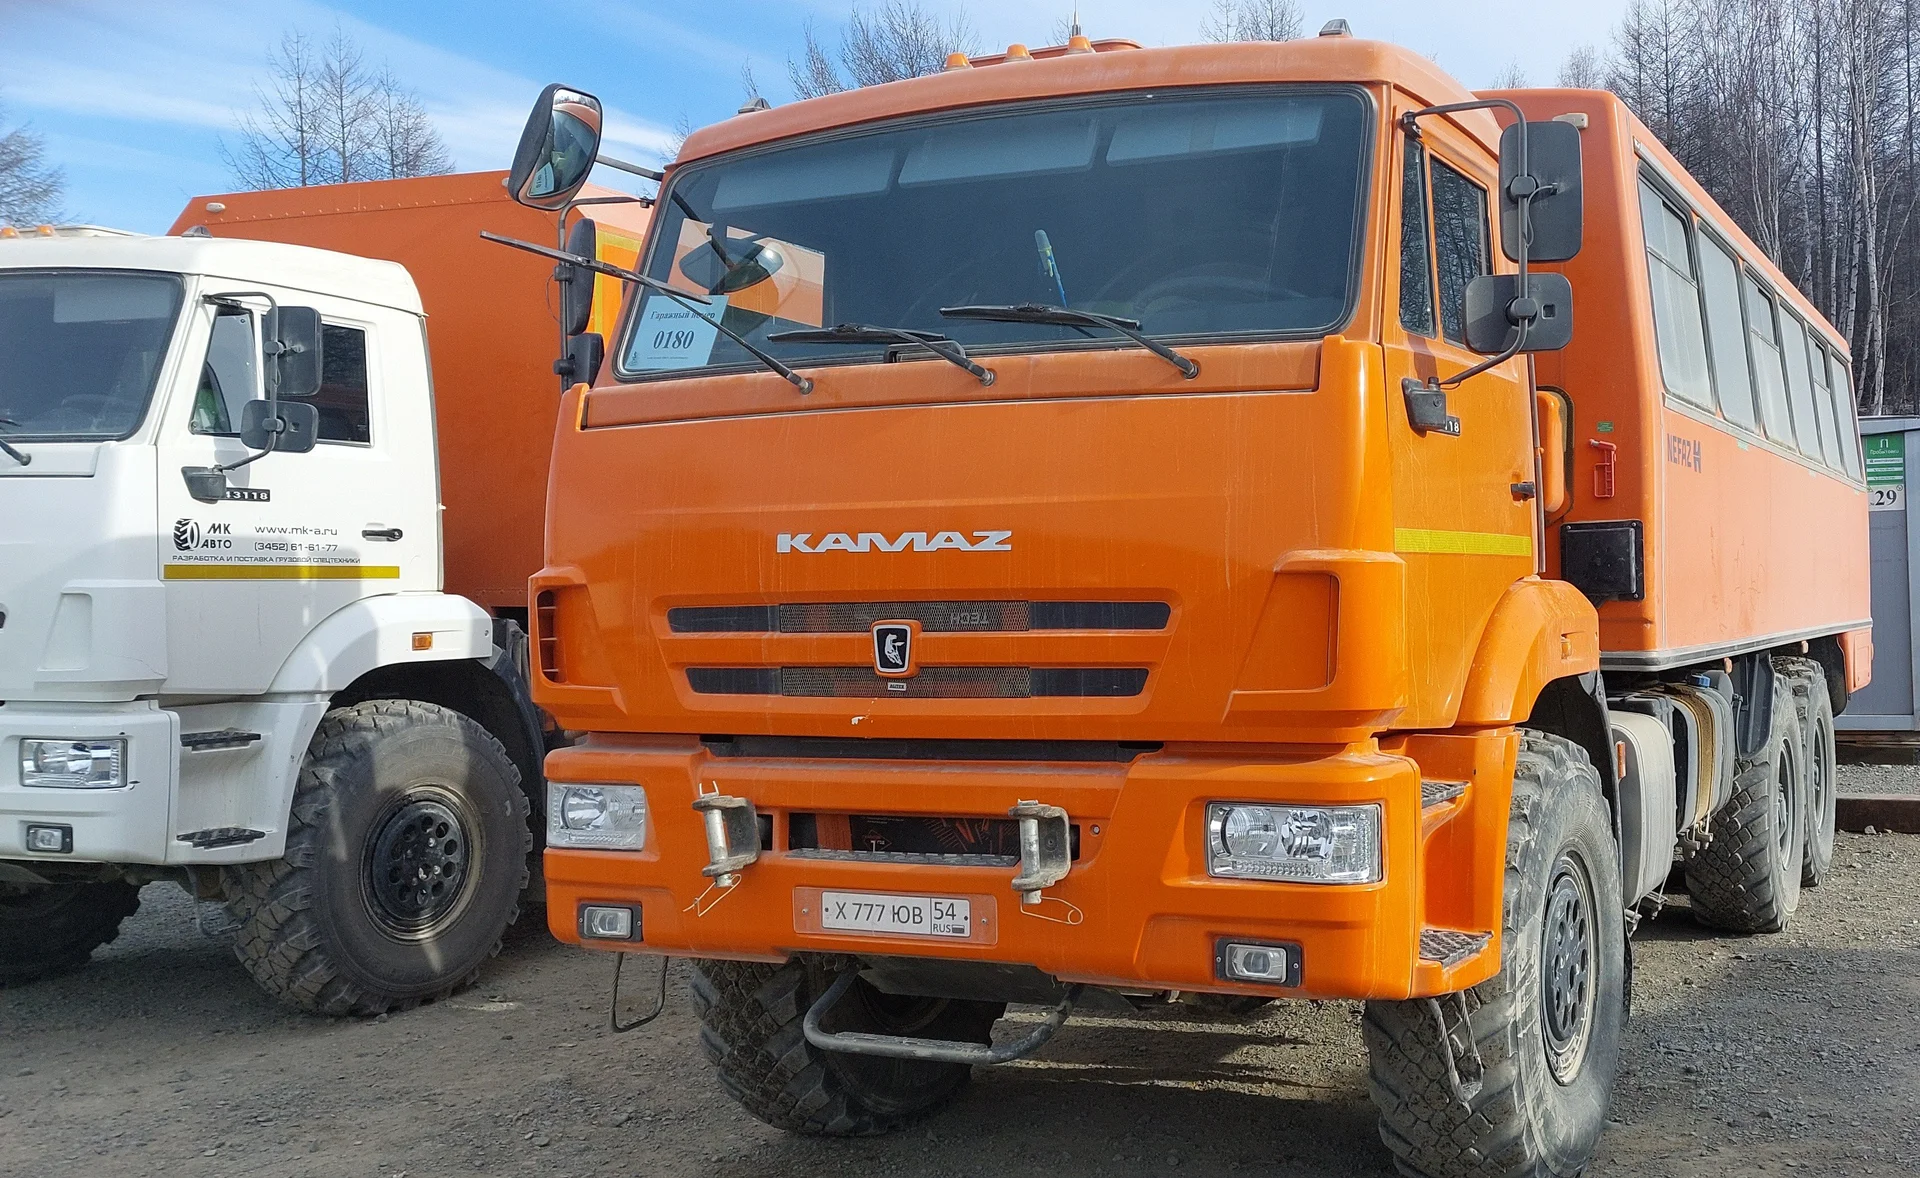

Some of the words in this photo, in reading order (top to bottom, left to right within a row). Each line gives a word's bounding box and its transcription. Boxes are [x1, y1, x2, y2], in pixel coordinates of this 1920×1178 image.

[650, 310, 690, 321] Гаражный
[653, 330, 695, 350] 0180
[1666, 433, 1692, 468] NEFAZ
[1874, 489, 1897, 506] 29
[207, 523, 232, 535] МК
[254, 525, 338, 536] www.mk-a.ru
[201, 539, 232, 549] АВТО
[254, 541, 289, 552] (3452)
[290, 542, 339, 552] 61-61-77
[776, 530, 1013, 553] KAMAZ
[852, 902, 885, 922] 777
[892, 904, 924, 925] ЮВ
[933, 901, 957, 921] 54
[932, 923, 952, 934] RUS
